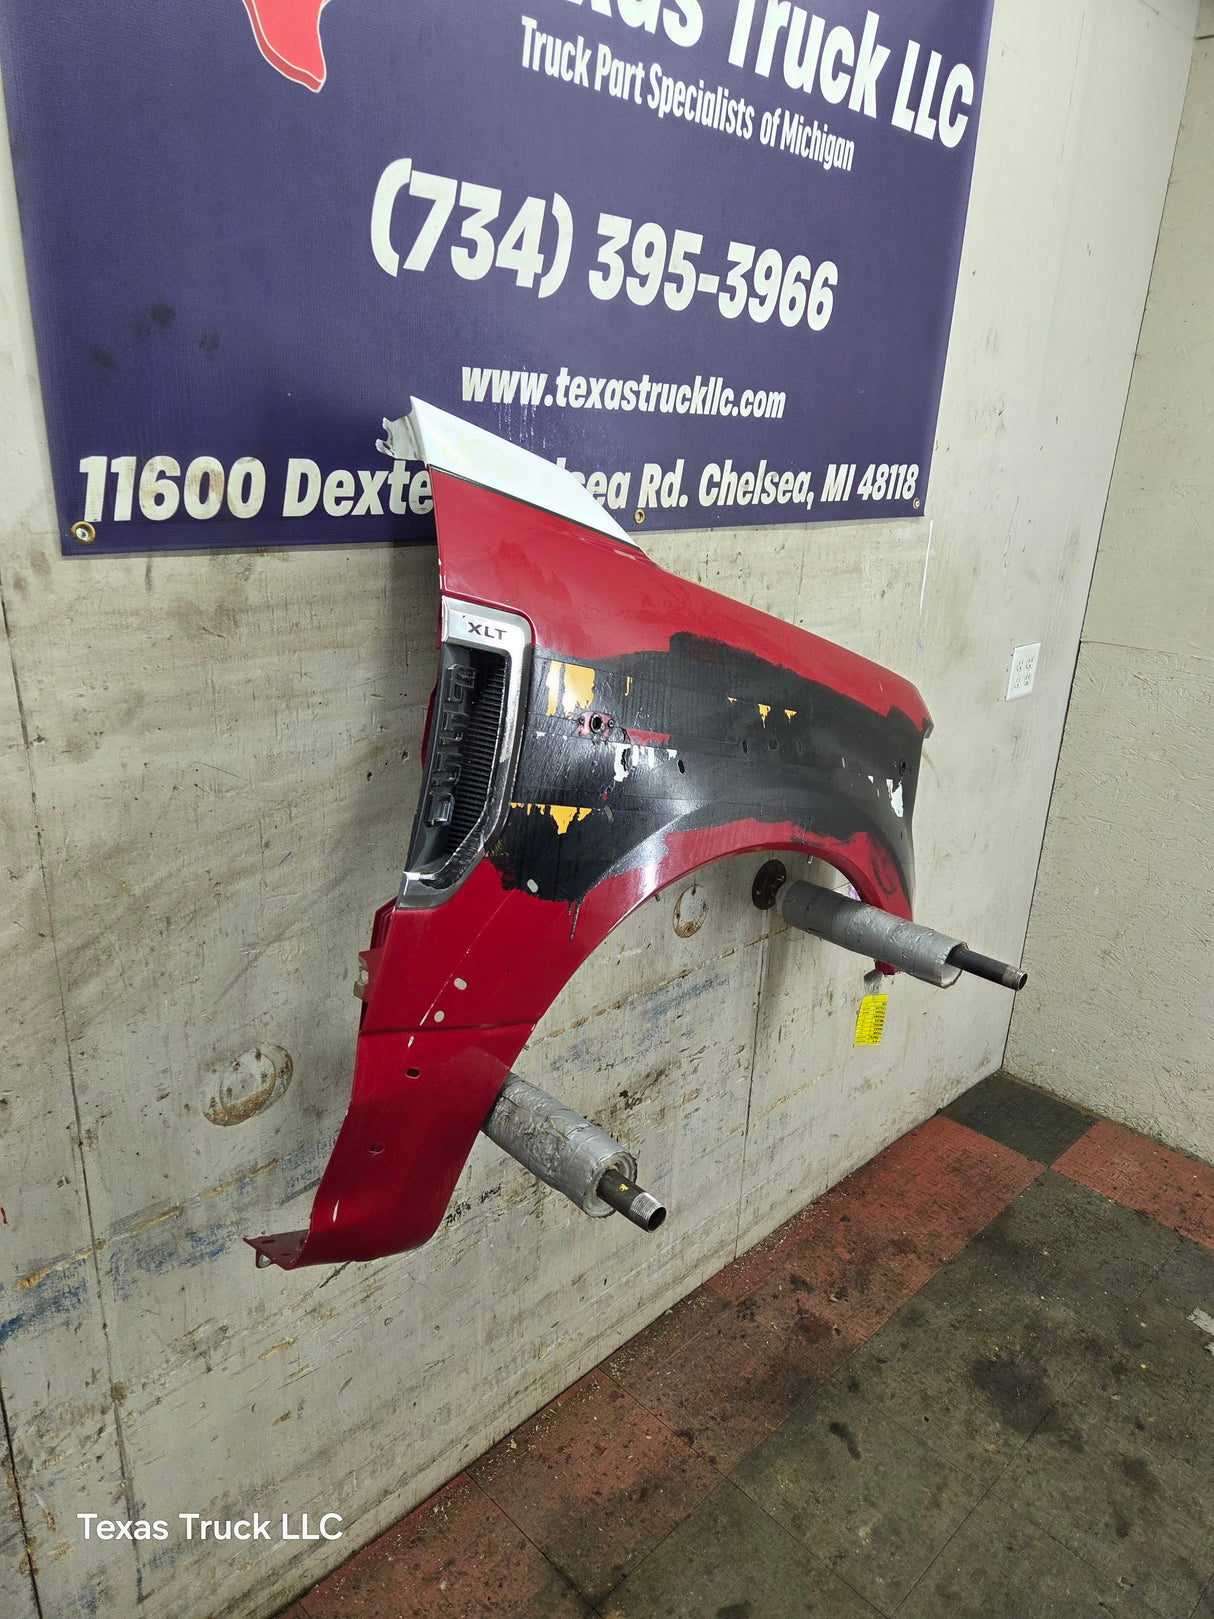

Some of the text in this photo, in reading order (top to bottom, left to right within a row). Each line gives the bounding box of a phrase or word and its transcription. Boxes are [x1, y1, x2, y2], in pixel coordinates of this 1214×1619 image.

[521, 15, 592, 88] Truck
[594, 43, 645, 104] Part
[646, 62, 755, 140] Specialists
[760, 107, 782, 148] of
[780, 109, 855, 172] Michigan
[891, 40, 975, 149] LLC
[371, 157, 839, 331] (734) 395-3966
[461, 366, 787, 419] www.texastruckllc.com
[79, 455, 266, 522] 11600
[637, 459, 689, 509] Rd.
[698, 459, 815, 511] Chelsea,
[820, 464, 857, 502] MI
[857, 463, 920, 501] 48118
[467, 621, 508, 641] XLT
